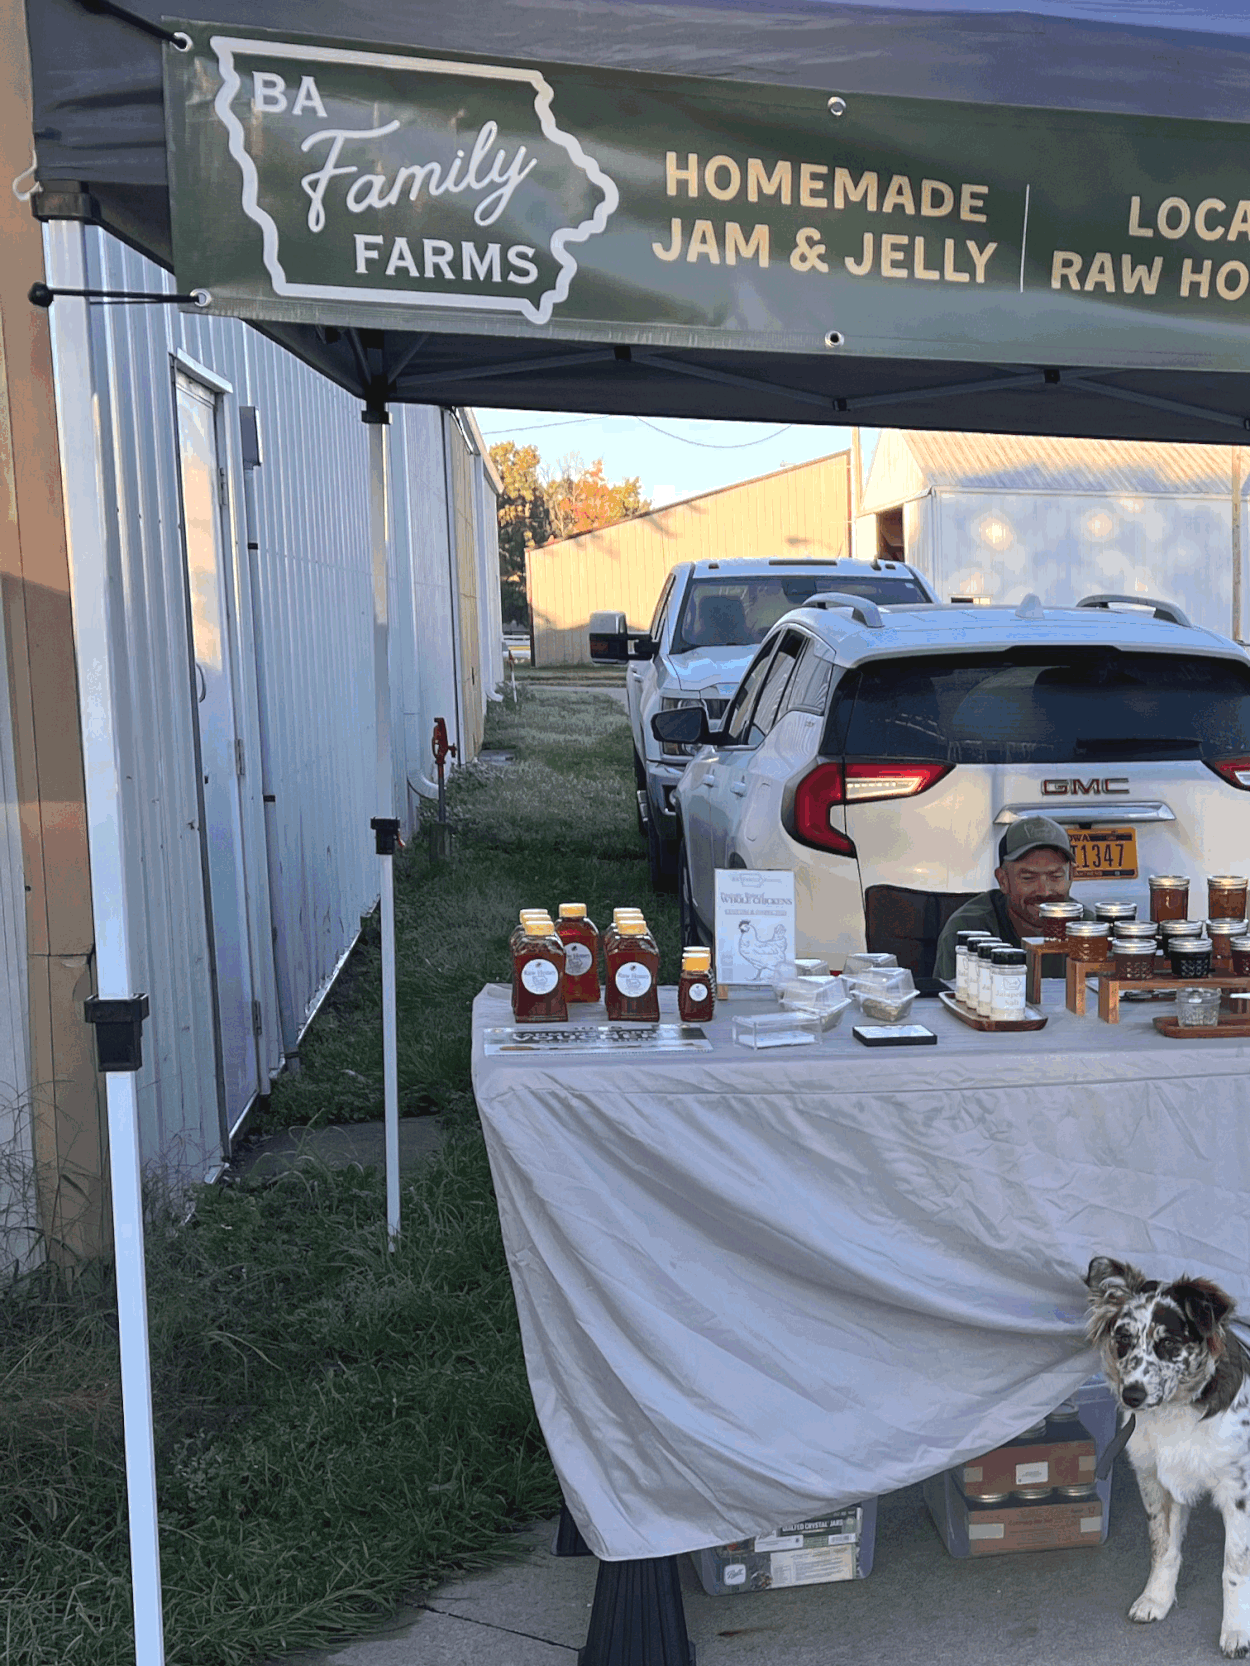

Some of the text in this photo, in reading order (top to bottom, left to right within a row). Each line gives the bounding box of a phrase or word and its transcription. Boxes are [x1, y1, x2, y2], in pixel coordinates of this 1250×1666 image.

[251, 70, 328, 118] BA
[301, 120, 538, 233] Family
[665, 151, 989, 223] HOMEMADE
[353, 233, 539, 285] FARMS
[651, 217, 999, 284] JAM & JELLY
[1050, 249, 1164, 295] RAW
[1041, 778, 1130, 795] GMC
